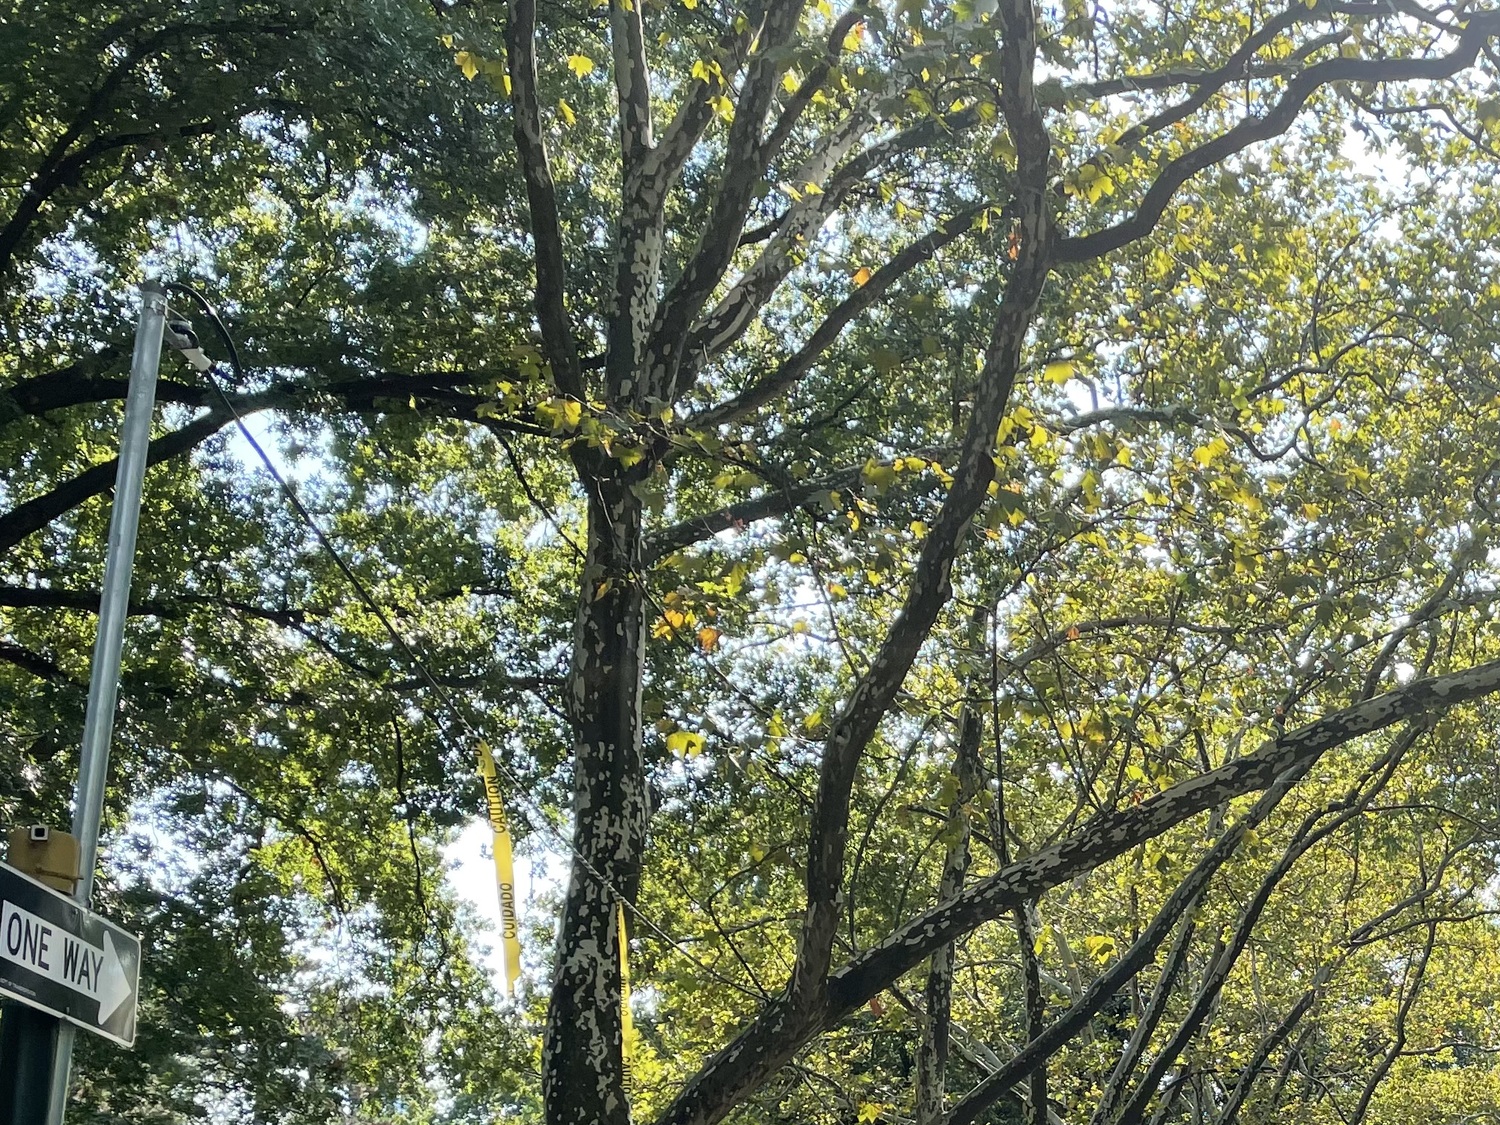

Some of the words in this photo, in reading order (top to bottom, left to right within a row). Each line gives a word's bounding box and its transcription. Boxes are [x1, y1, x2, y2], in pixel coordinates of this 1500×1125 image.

[487, 776, 506, 834] CAUTION
[500, 883, 516, 939] CUIDADO
[7, 912, 52, 971] ONE
[63, 937, 104, 993] WAY
[622, 1056, 632, 1094] CAUTIO
